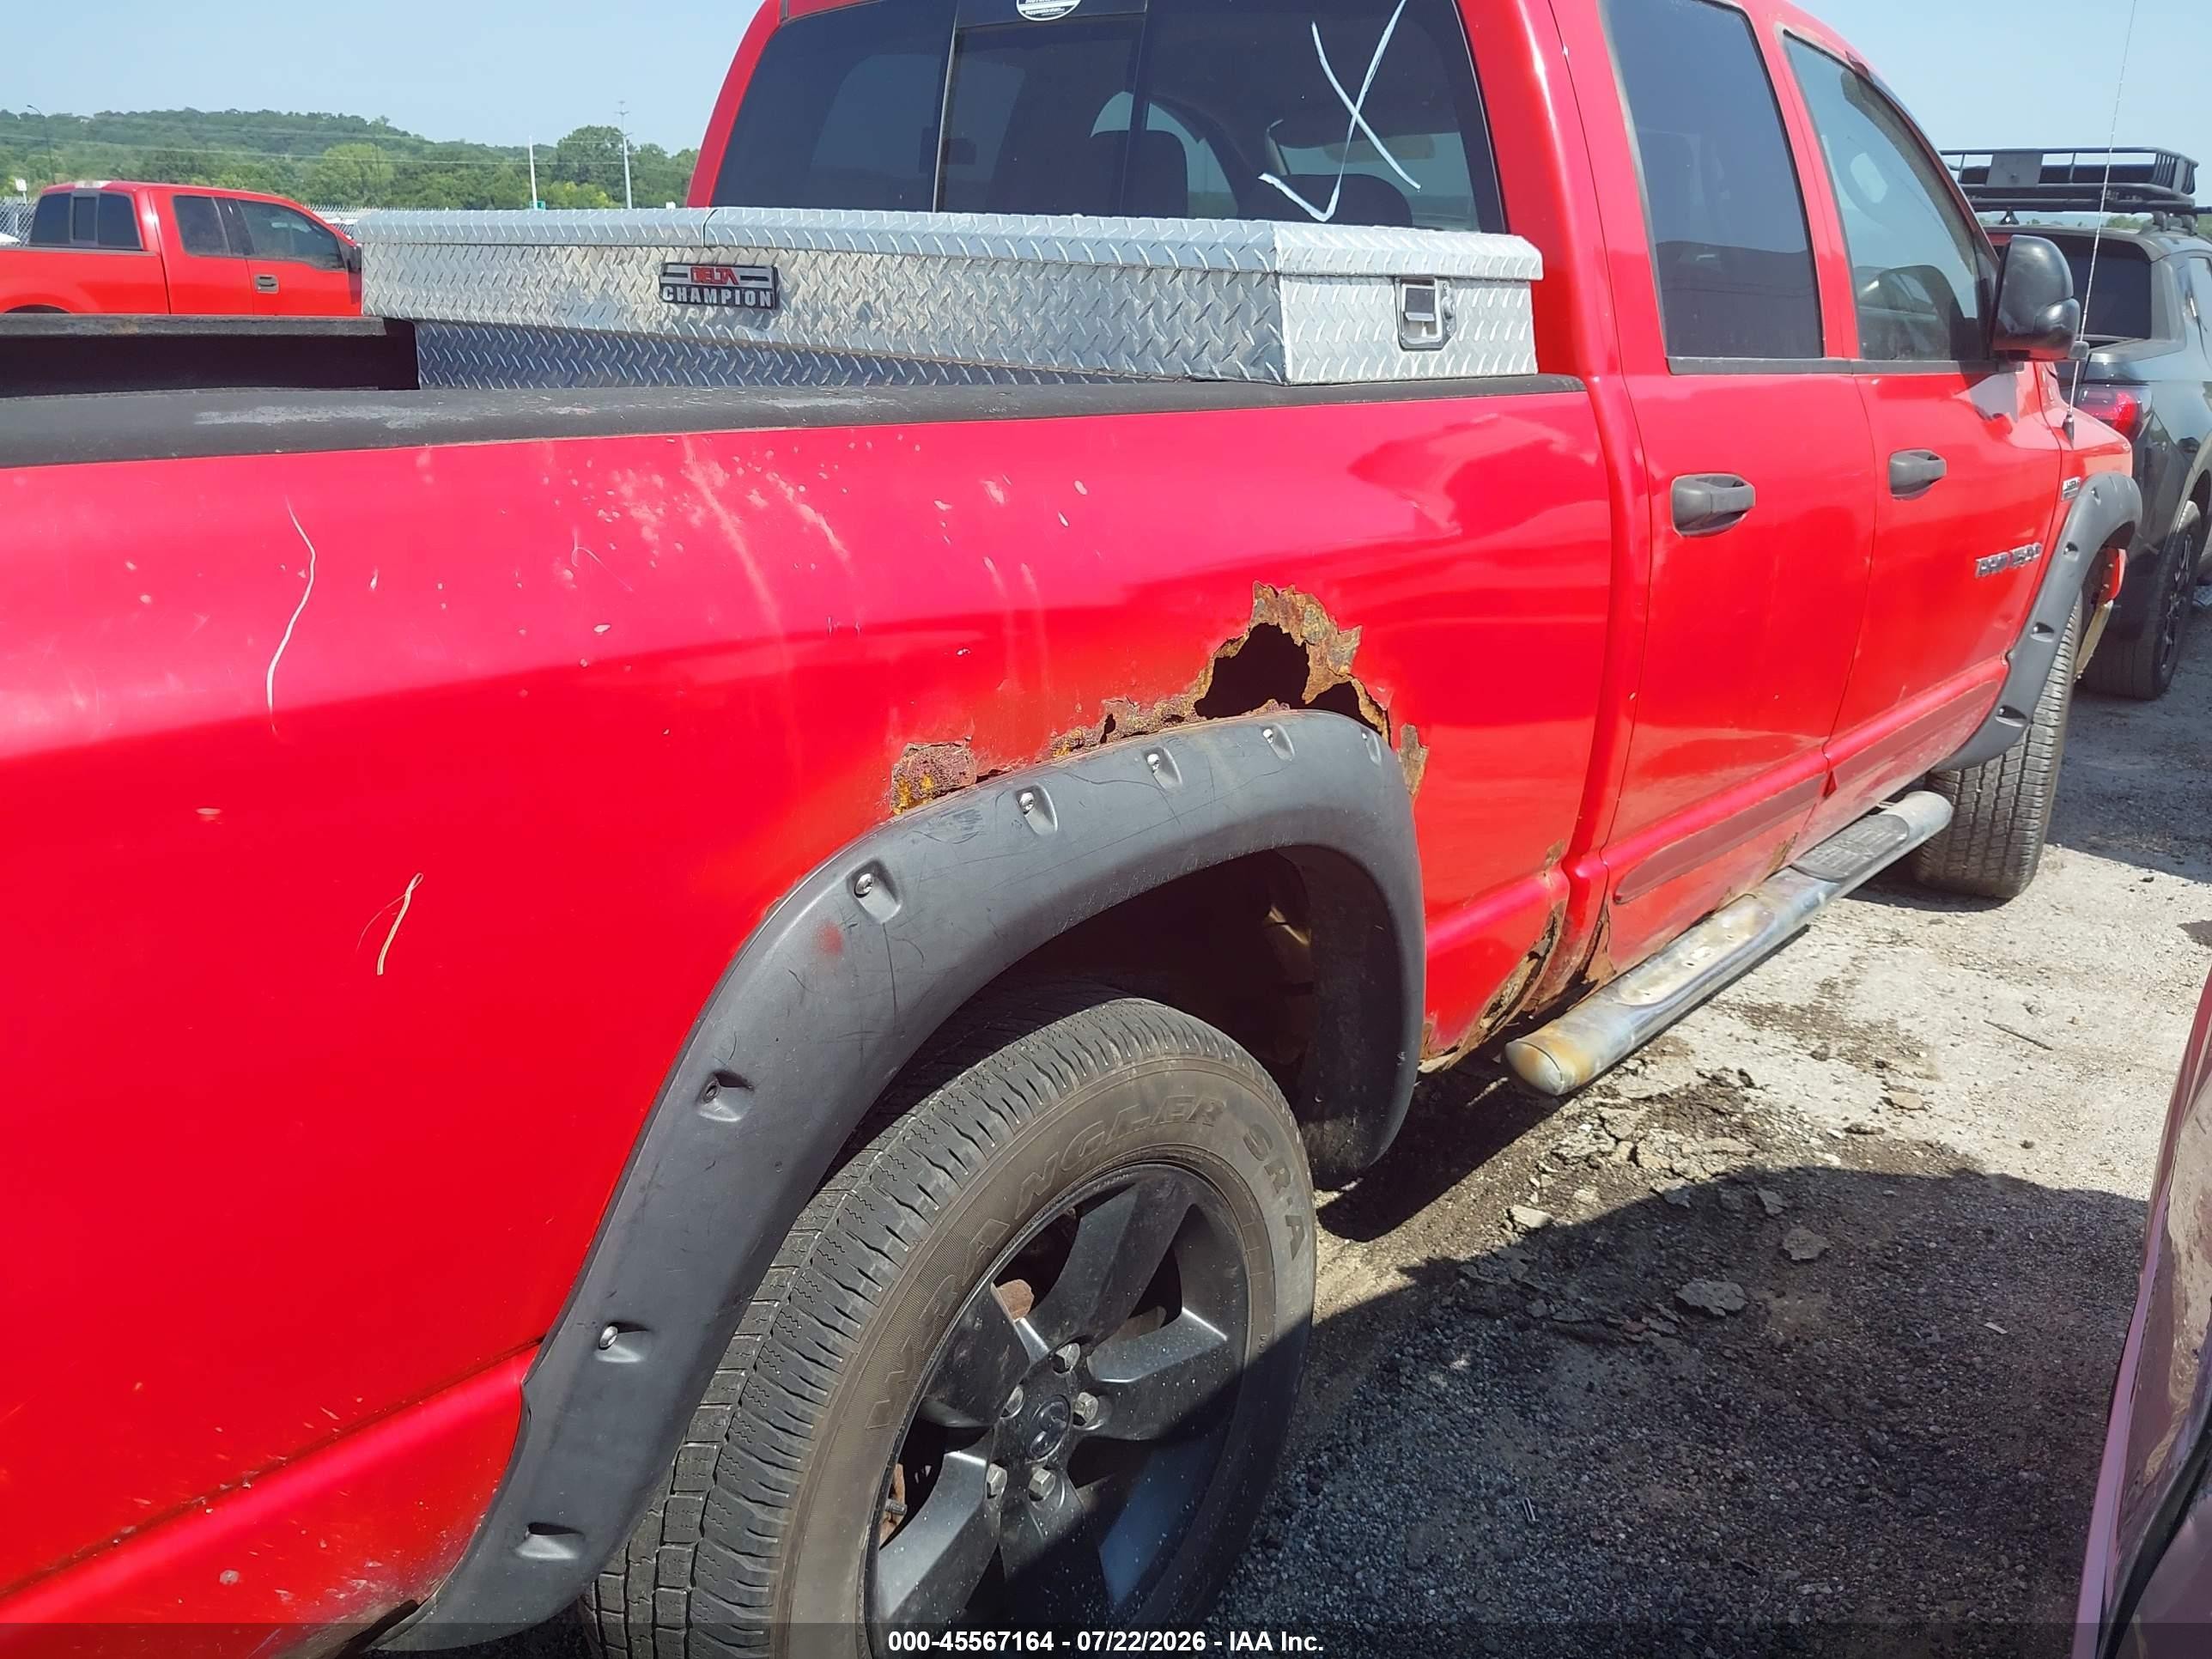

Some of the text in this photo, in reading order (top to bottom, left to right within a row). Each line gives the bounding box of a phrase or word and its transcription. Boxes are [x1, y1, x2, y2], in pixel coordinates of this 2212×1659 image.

[690, 266, 739, 286] DELTA
[662, 287, 772, 307] CHAMPION
[866, 1095, 1226, 1429] WRANGLER
